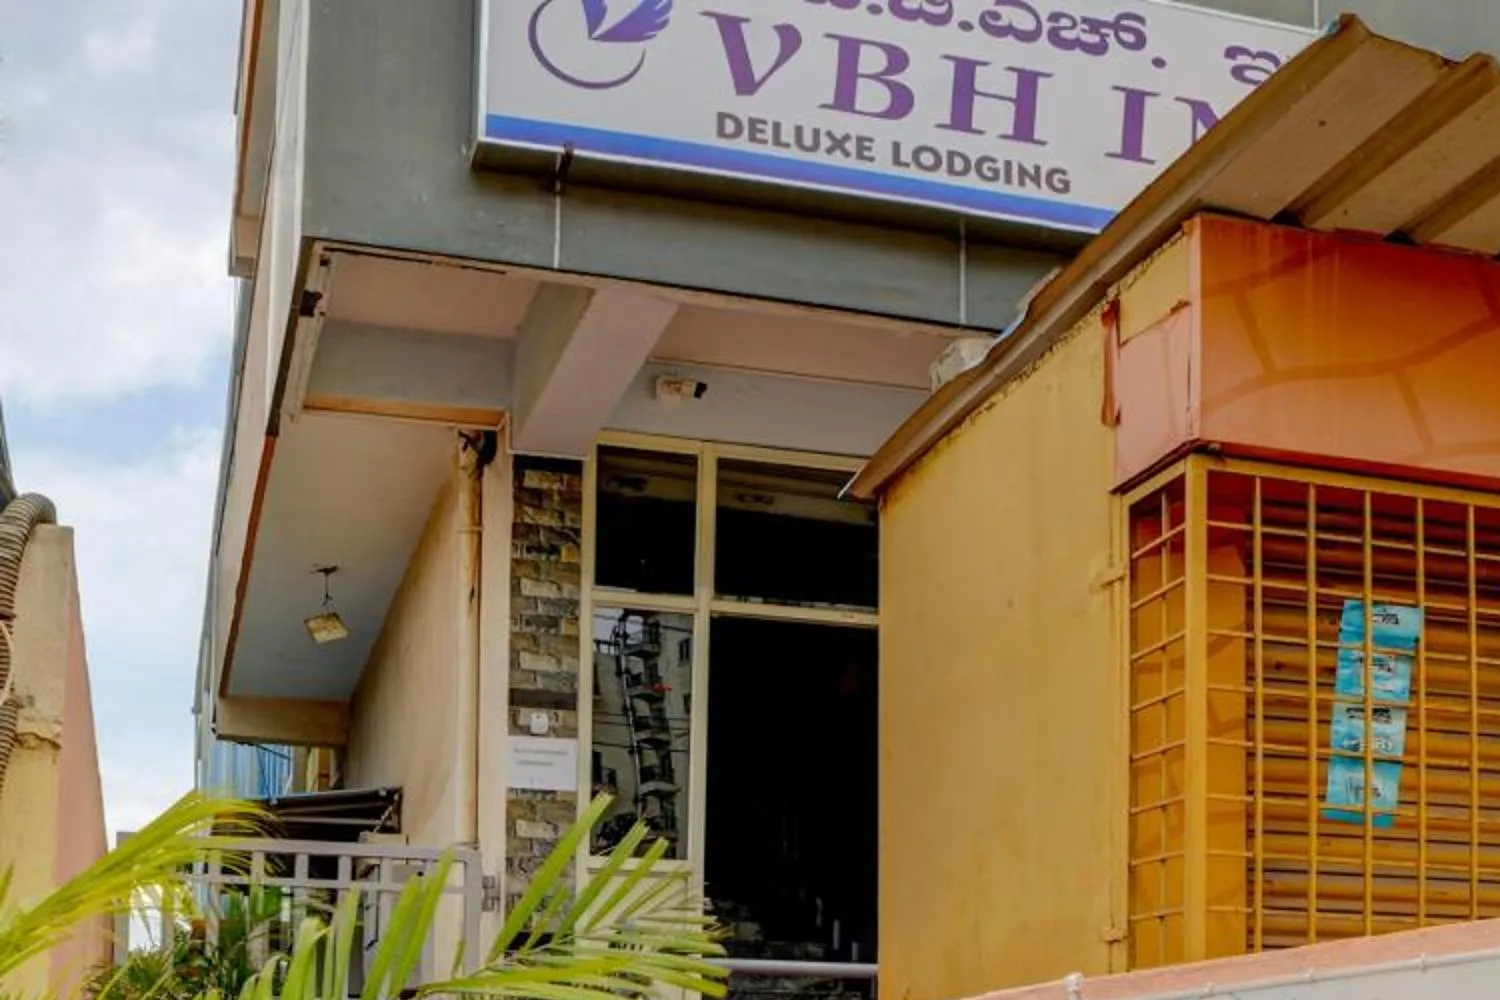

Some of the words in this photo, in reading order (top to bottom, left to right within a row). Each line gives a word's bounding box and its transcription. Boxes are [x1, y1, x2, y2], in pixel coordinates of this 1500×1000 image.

[697, 10, 1055, 147] VBH
[716, 111, 876, 163] DELUXE
[891, 140, 1071, 195] LODGING
